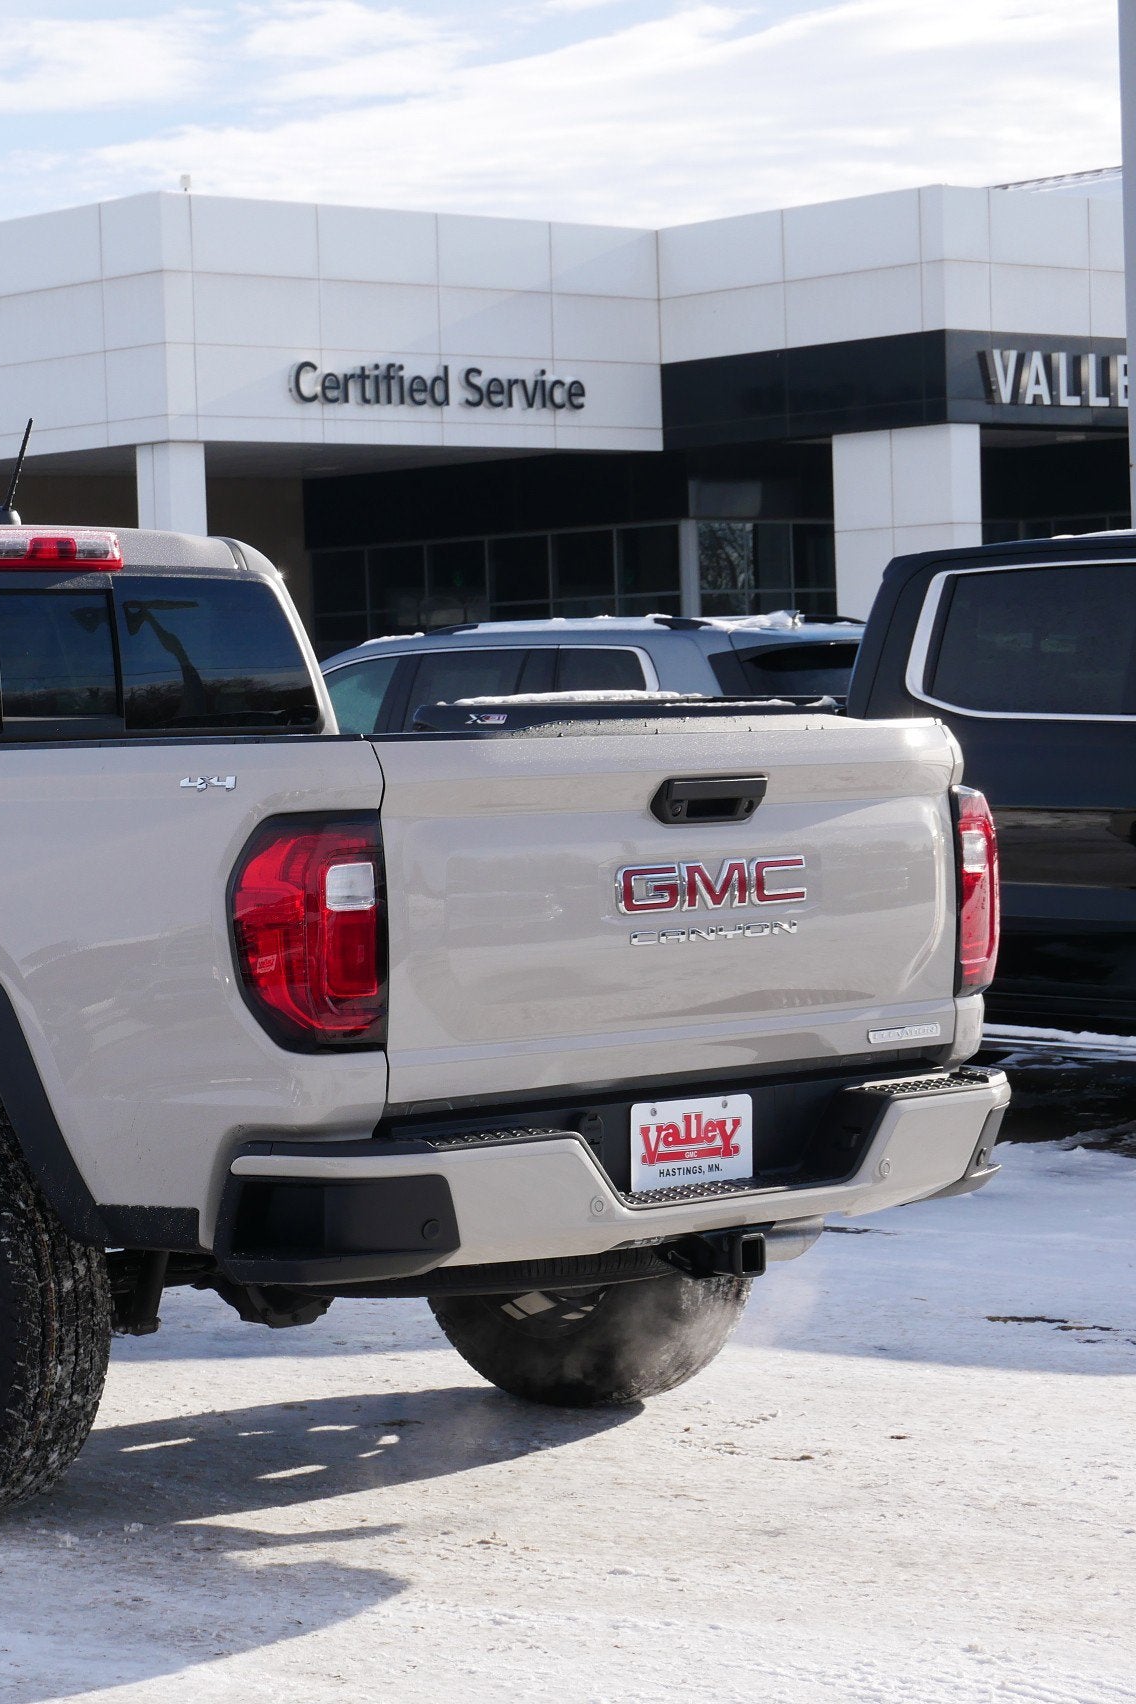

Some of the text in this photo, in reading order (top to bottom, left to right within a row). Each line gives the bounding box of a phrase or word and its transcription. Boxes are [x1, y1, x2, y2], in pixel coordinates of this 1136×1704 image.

[289, 361, 586, 411] Certified Service
[616, 855, 807, 914] GMC
[630, 920, 798, 946] CANYON
[684, 1150, 698, 1159] GMC
[659, 1163, 723, 1178] HASTINGS, MN.
